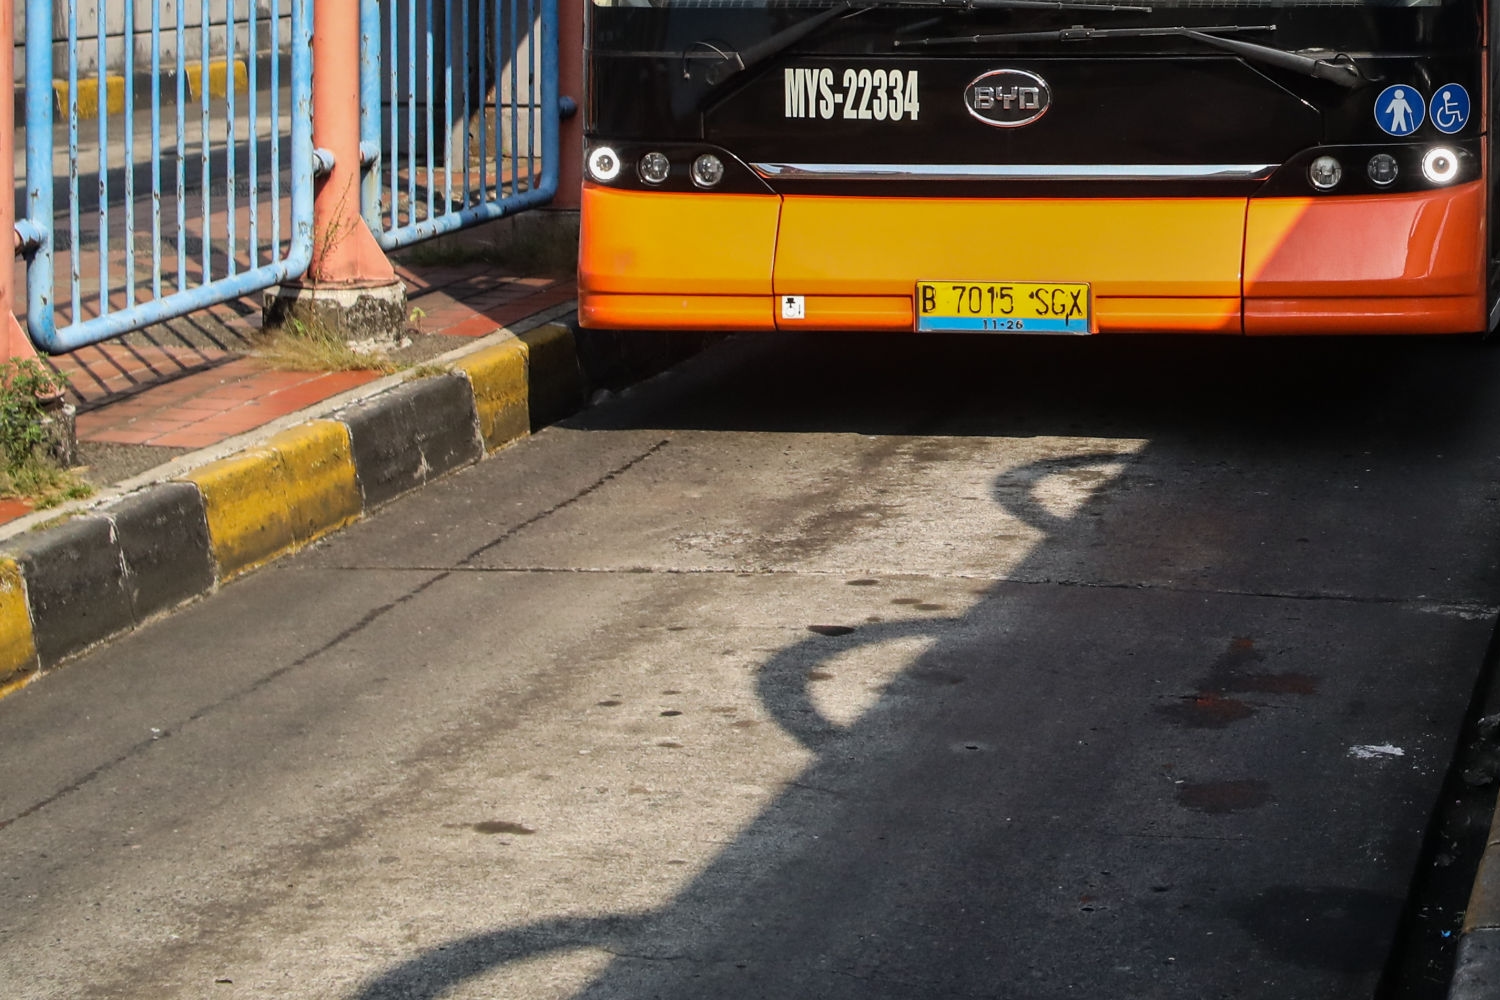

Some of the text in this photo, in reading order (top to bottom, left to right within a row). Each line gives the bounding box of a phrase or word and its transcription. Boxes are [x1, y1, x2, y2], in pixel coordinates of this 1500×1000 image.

[784, 68, 920, 121] MYS-22334
[974, 86, 1039, 110] BYD
[922, 285, 1083, 317] B 7015 SGX
